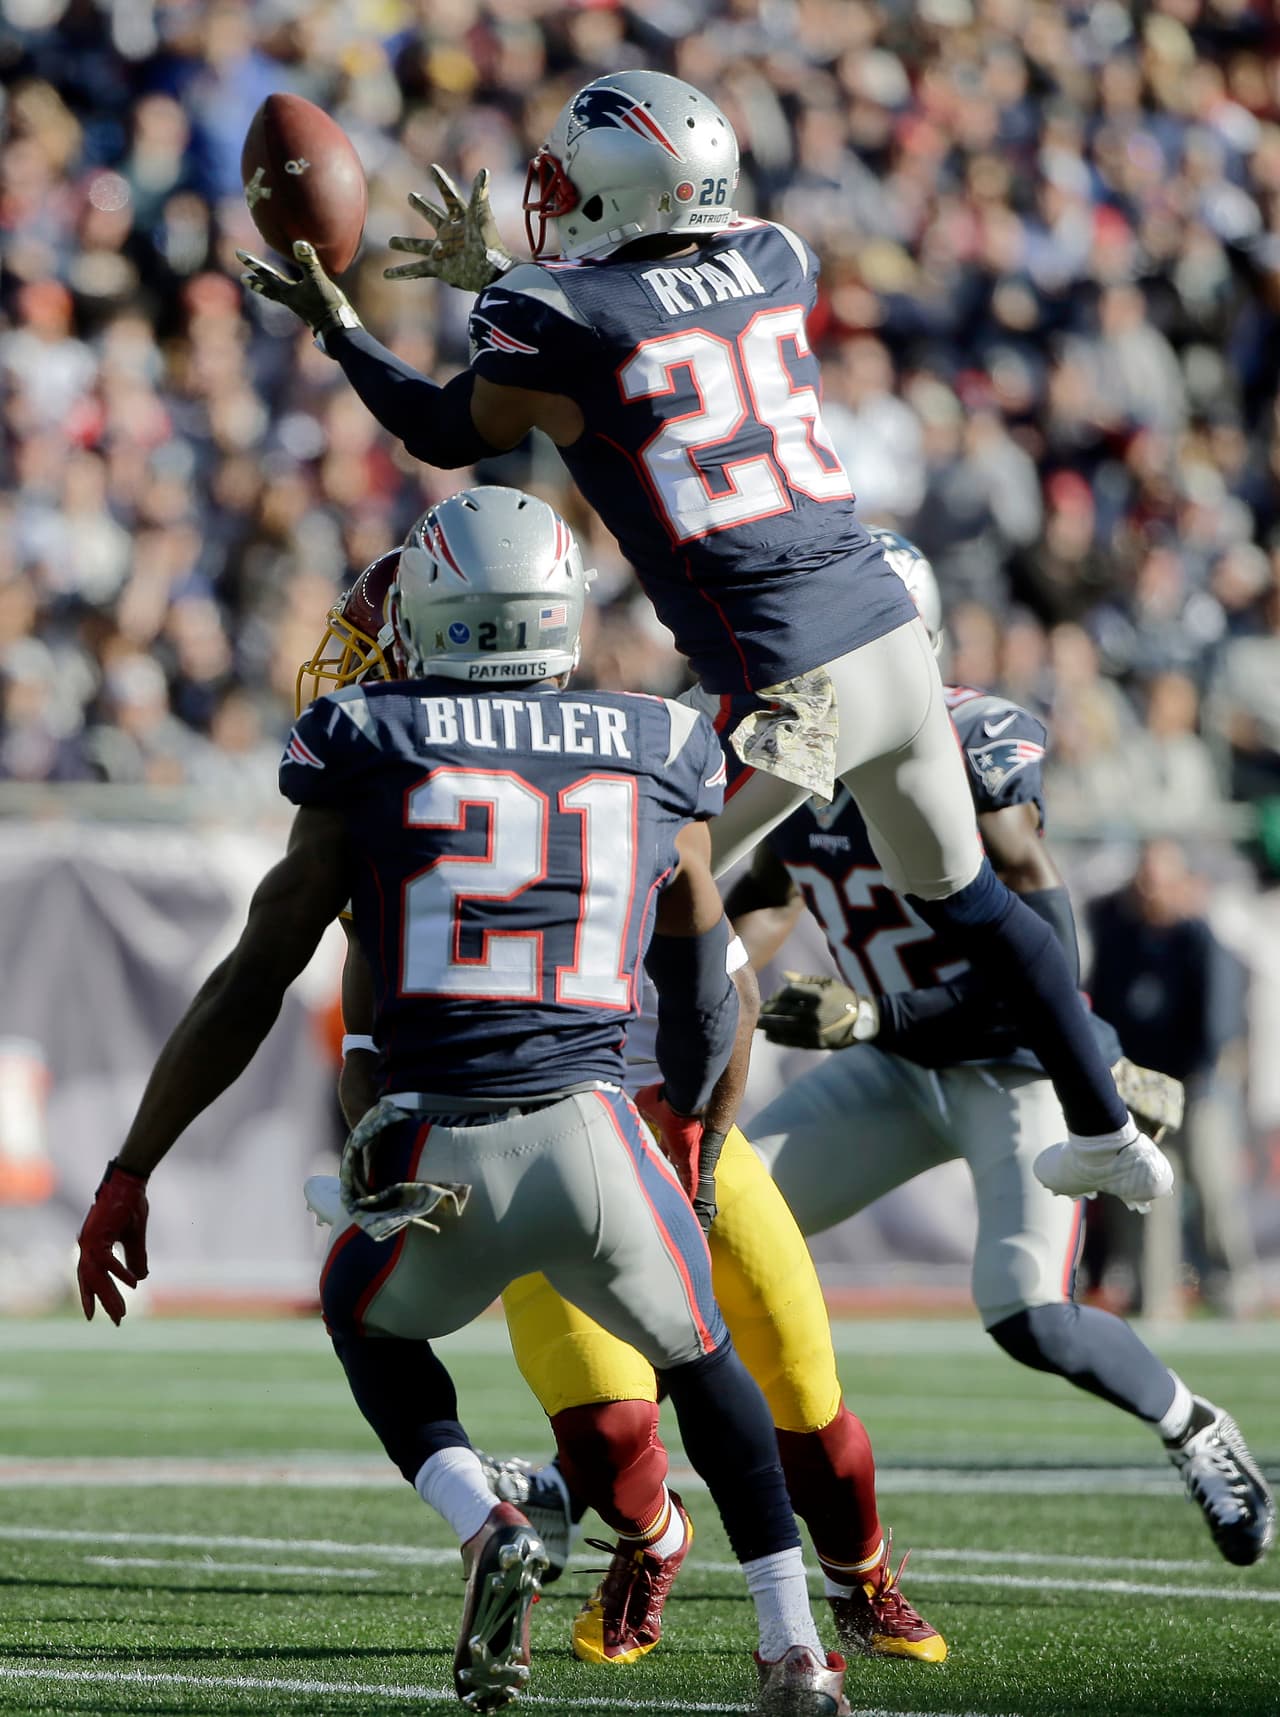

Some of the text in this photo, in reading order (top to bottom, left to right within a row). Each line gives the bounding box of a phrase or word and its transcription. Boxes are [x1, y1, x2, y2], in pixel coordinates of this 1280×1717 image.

[698, 177, 728, 206] 26
[641, 248, 767, 316] RYAN
[614, 303, 856, 546] 26
[477, 621, 528, 651] 21
[468, 661, 548, 679] PATRIOTS
[420, 697, 632, 760] BUTLER
[397, 765, 639, 1012] 21
